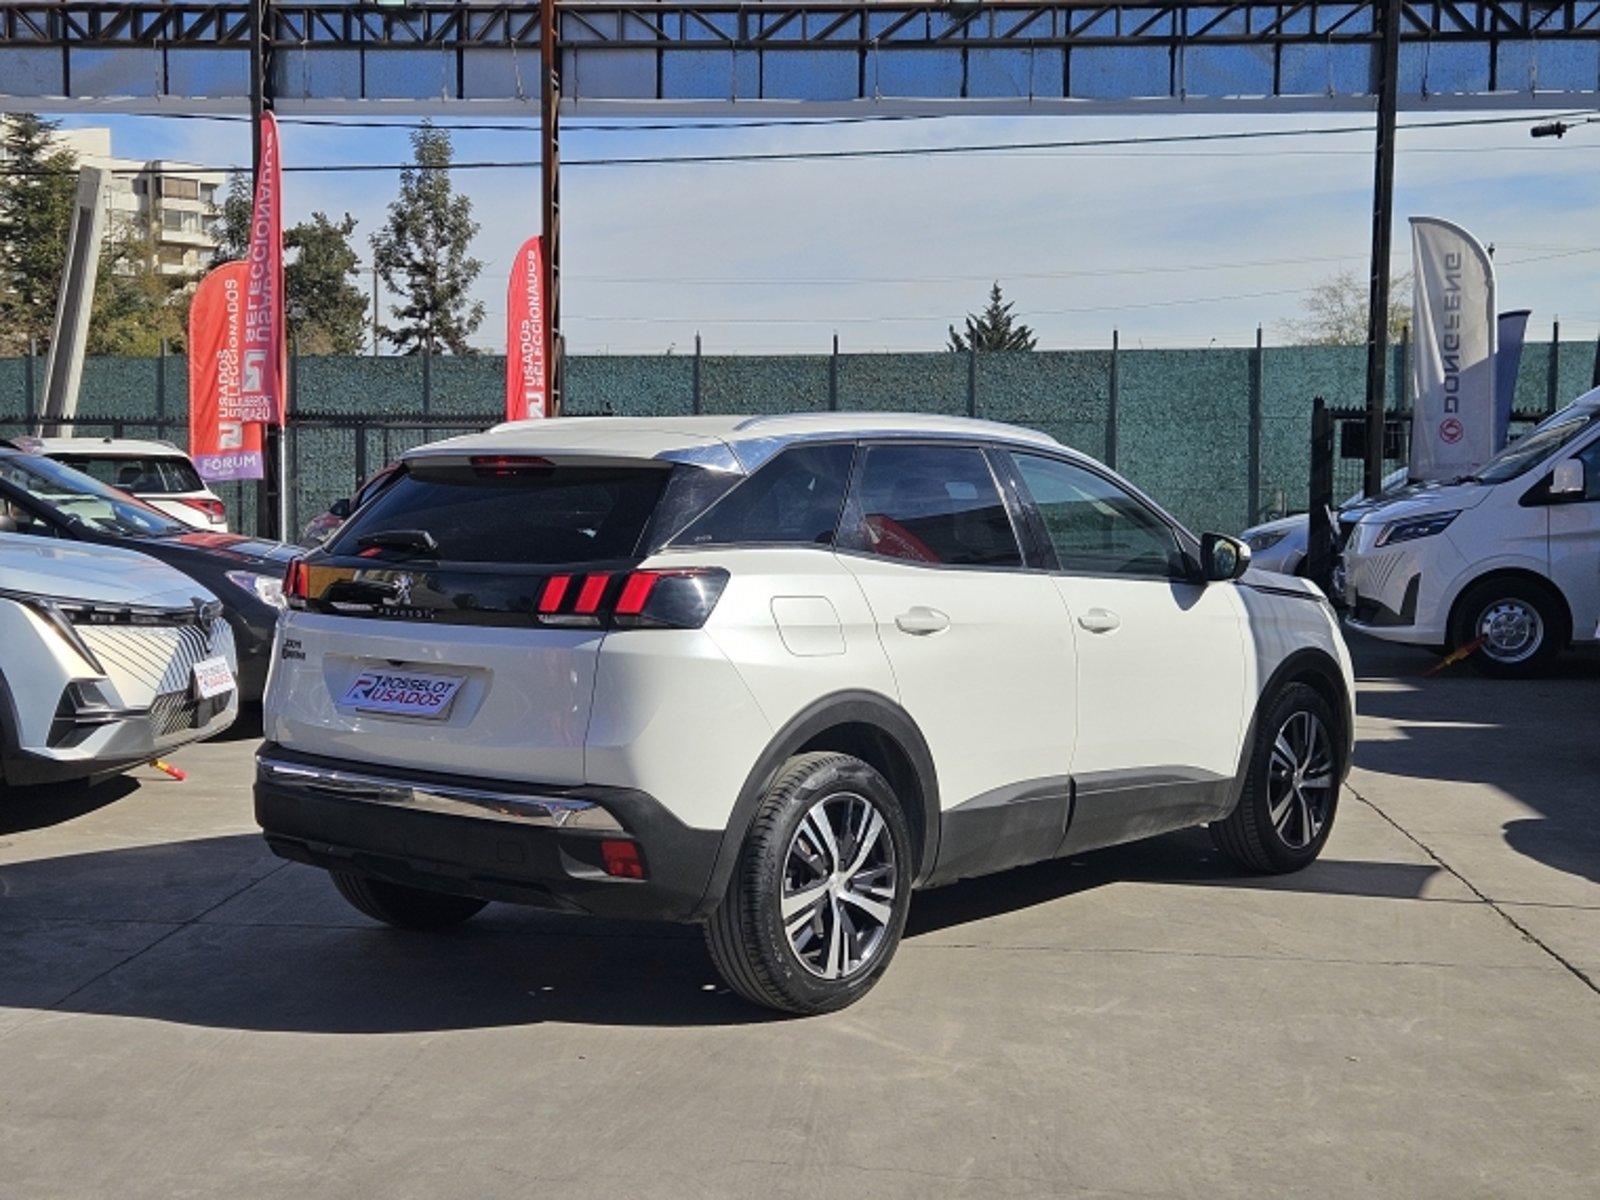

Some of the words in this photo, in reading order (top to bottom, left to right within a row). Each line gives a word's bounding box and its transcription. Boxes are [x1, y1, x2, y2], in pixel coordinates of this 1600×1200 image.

[225, 278, 242, 418] SELECCIONADOS
[527, 250, 544, 387] SELECCIONADOS
[217, 348, 231, 418] USADOS
[520, 319, 535, 387] USADOS
[203, 455, 256, 470] FORUM
[371, 688, 445, 706] USADOS
[380, 676, 455, 693] ROSSELOT
